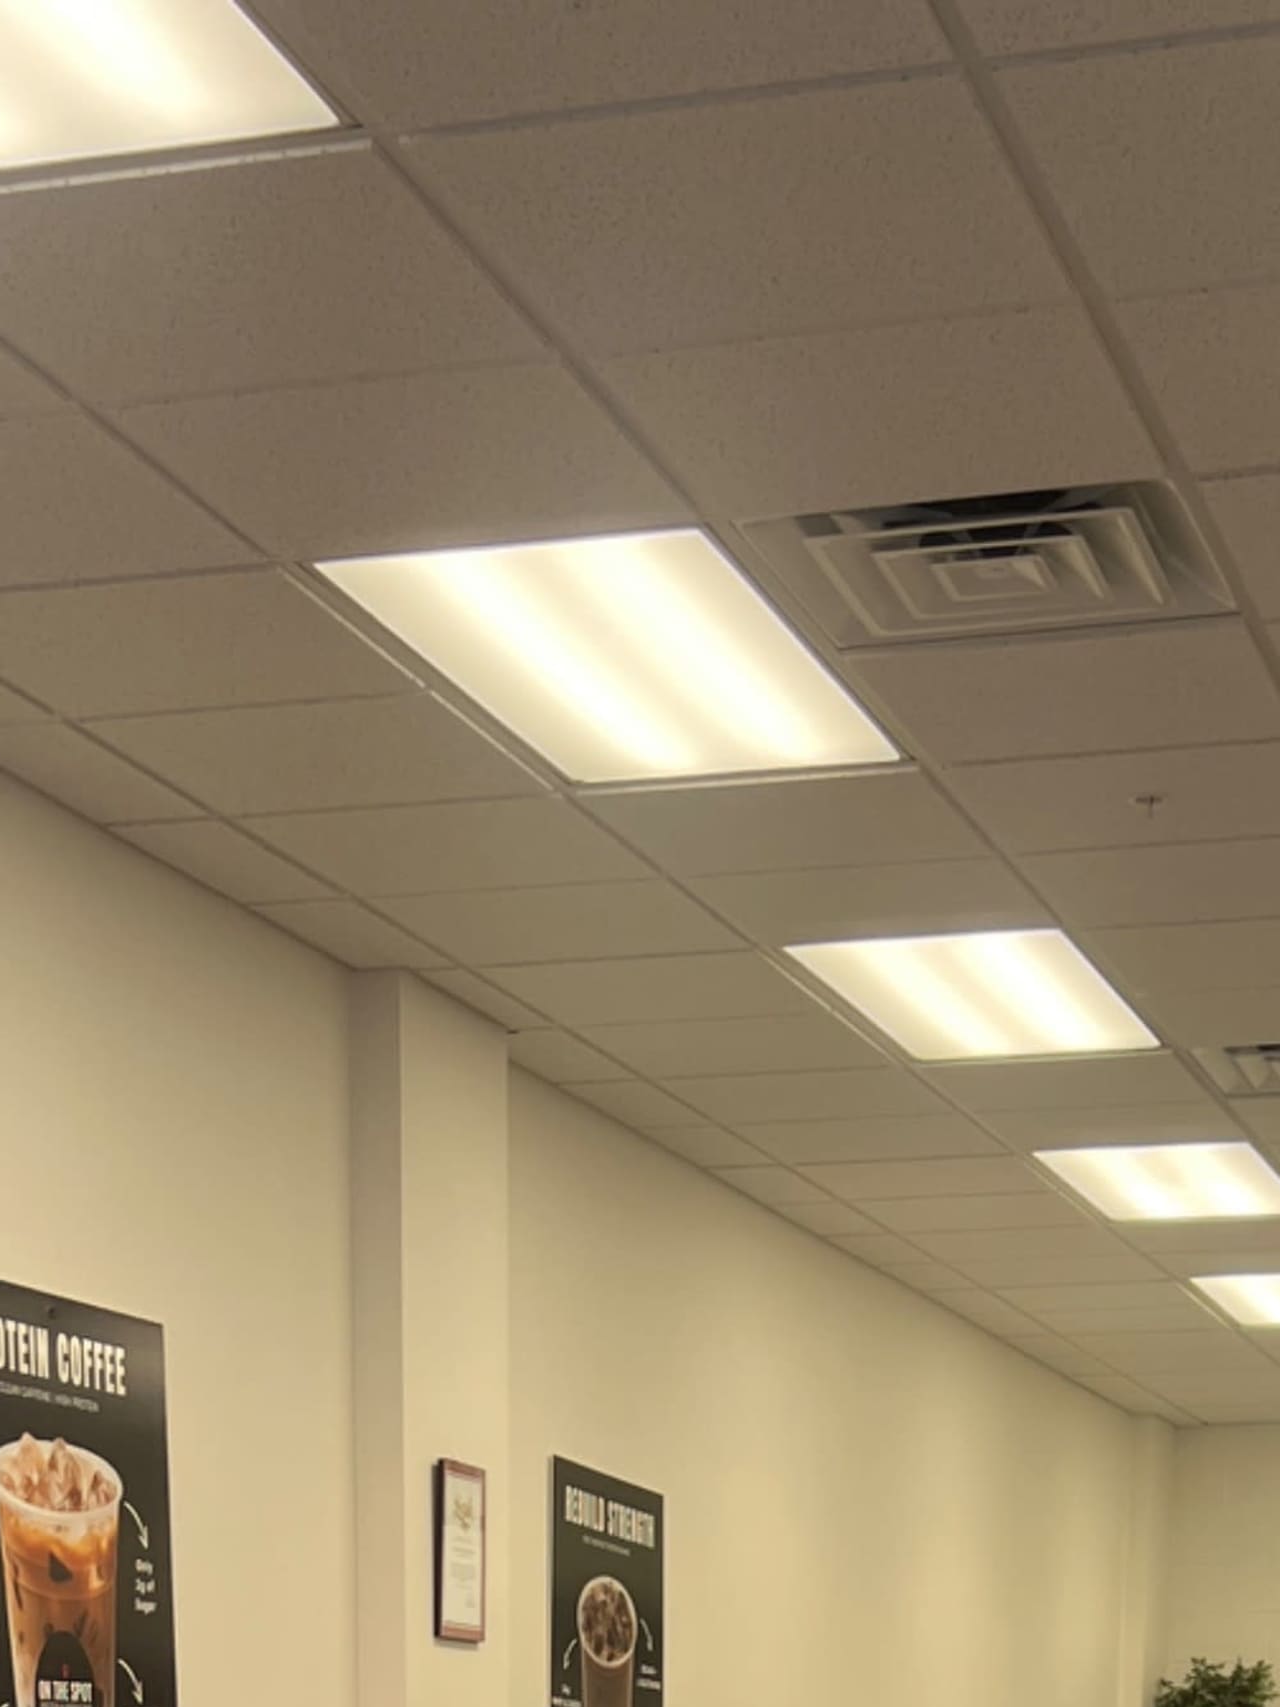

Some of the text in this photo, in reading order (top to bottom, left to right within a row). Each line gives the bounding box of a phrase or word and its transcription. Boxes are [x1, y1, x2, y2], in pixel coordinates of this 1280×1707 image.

[56, 1332, 126, 1396] COFFEE
[39, 1680, 92, 1703] ON THE SPOT
